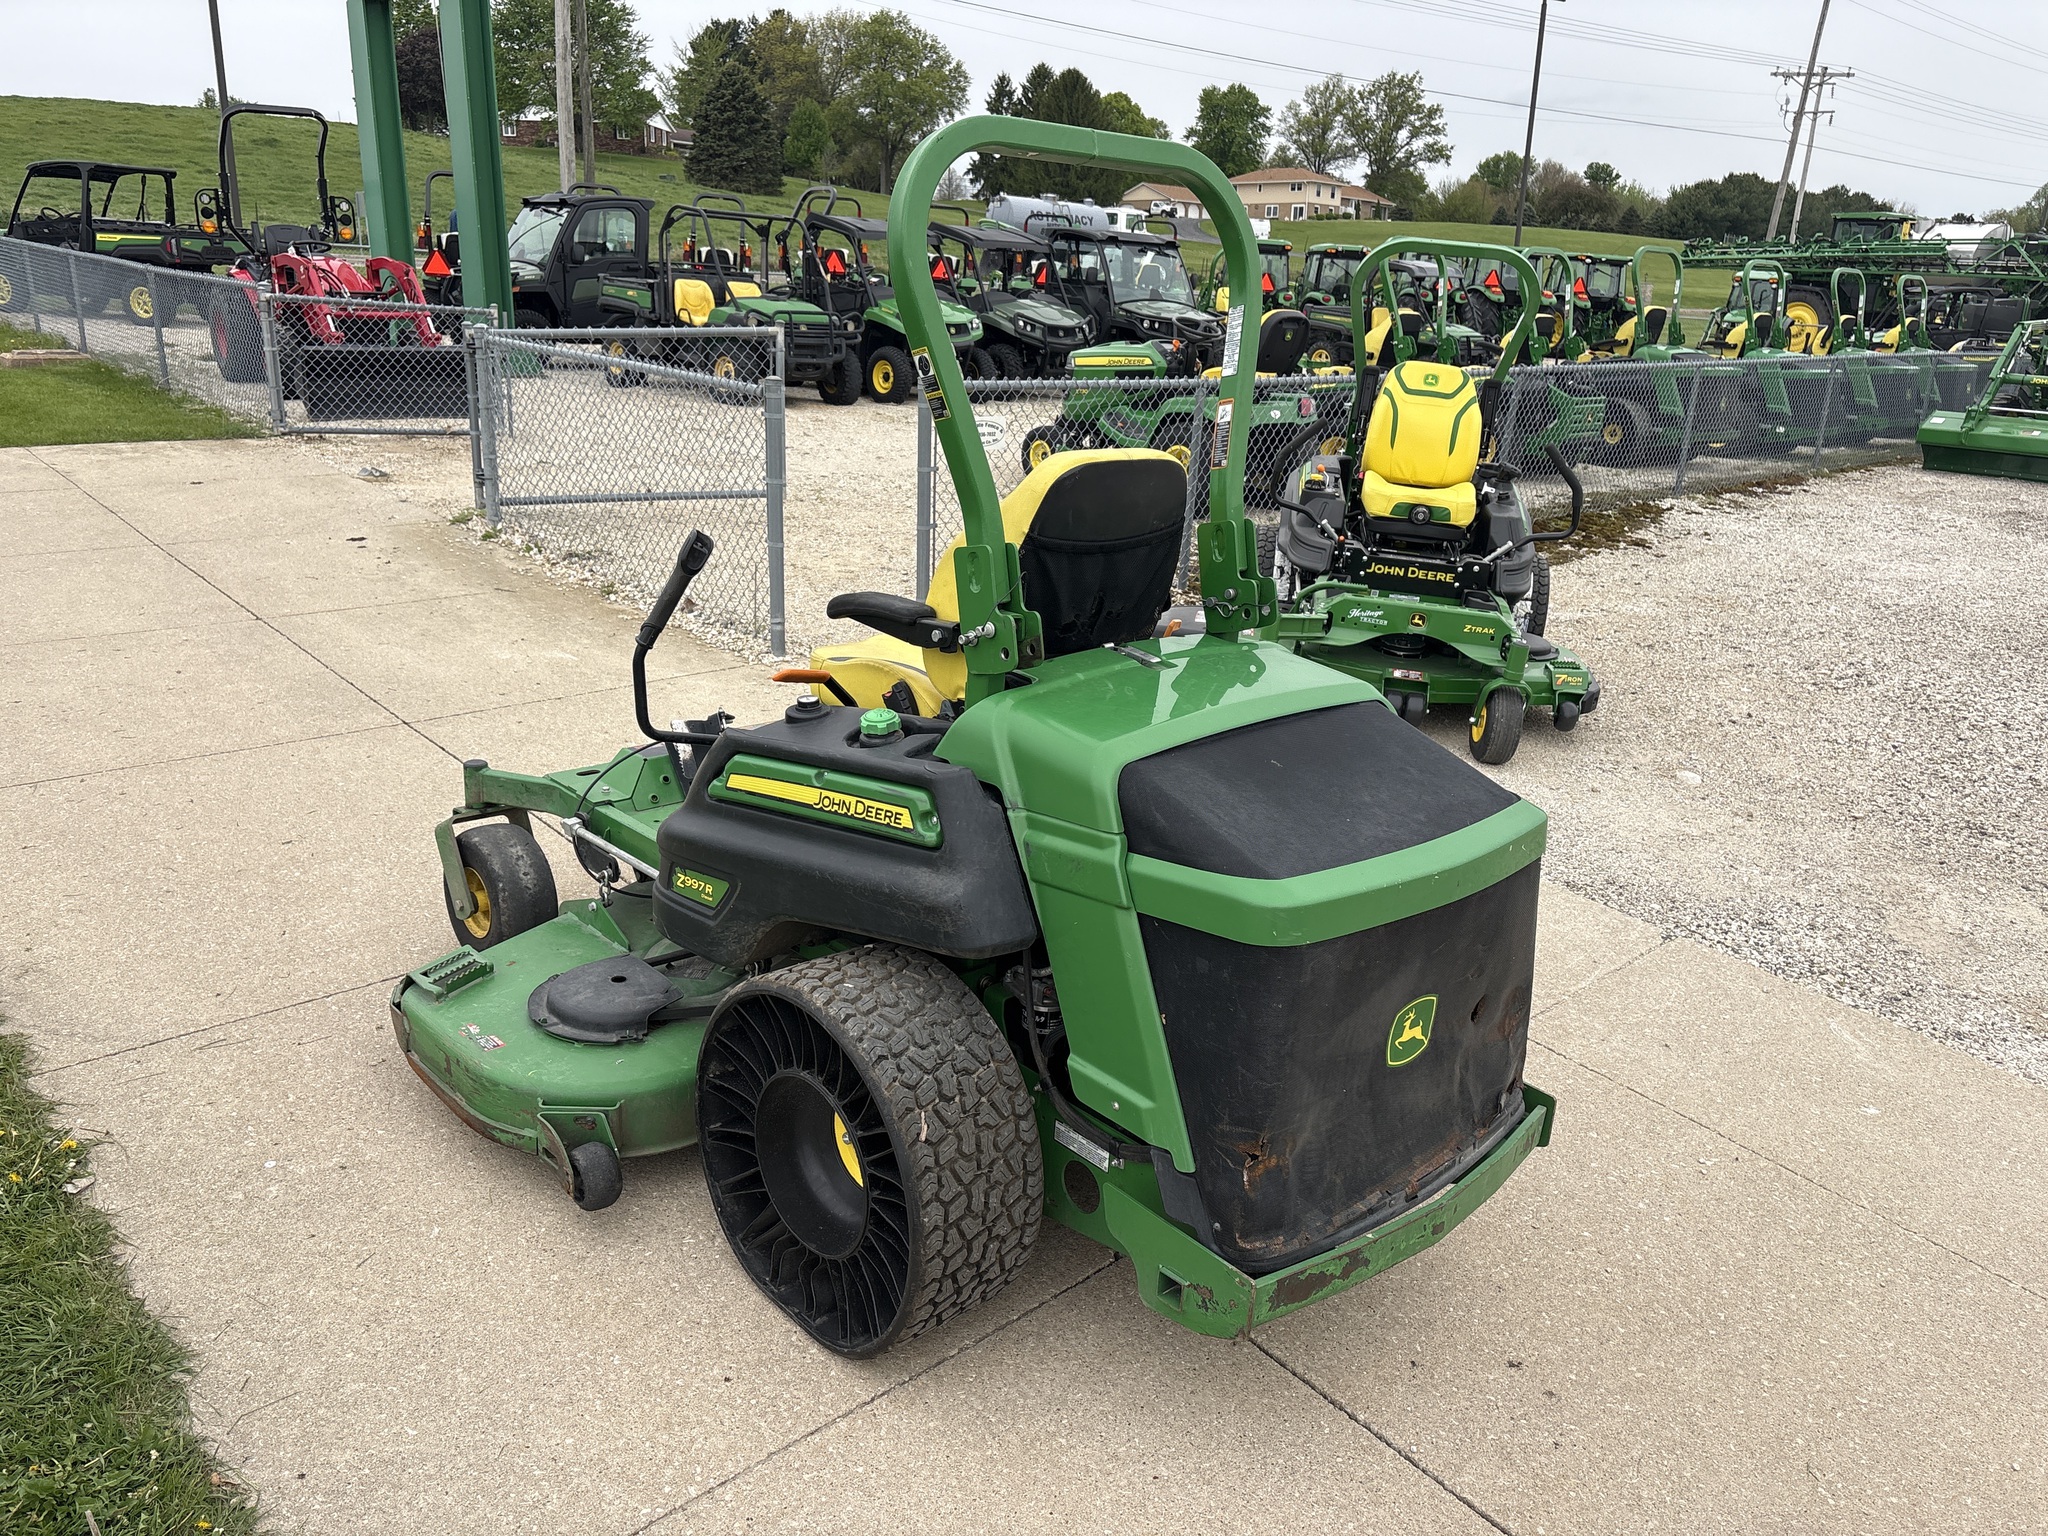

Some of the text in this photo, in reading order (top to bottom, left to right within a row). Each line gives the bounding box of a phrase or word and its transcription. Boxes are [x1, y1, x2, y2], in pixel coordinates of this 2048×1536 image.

[1106, 358, 1122, 366] JOHN
[2029, 377, 2048, 385] JOH
[1366, 562, 1456, 583] JOHN DEERE
[1347, 608, 1384, 619] Heritage
[1463, 624, 1496, 635] ZTRAK
[813, 791, 904, 826] JOHN DEERE
[676, 873, 713, 896] Z997R
